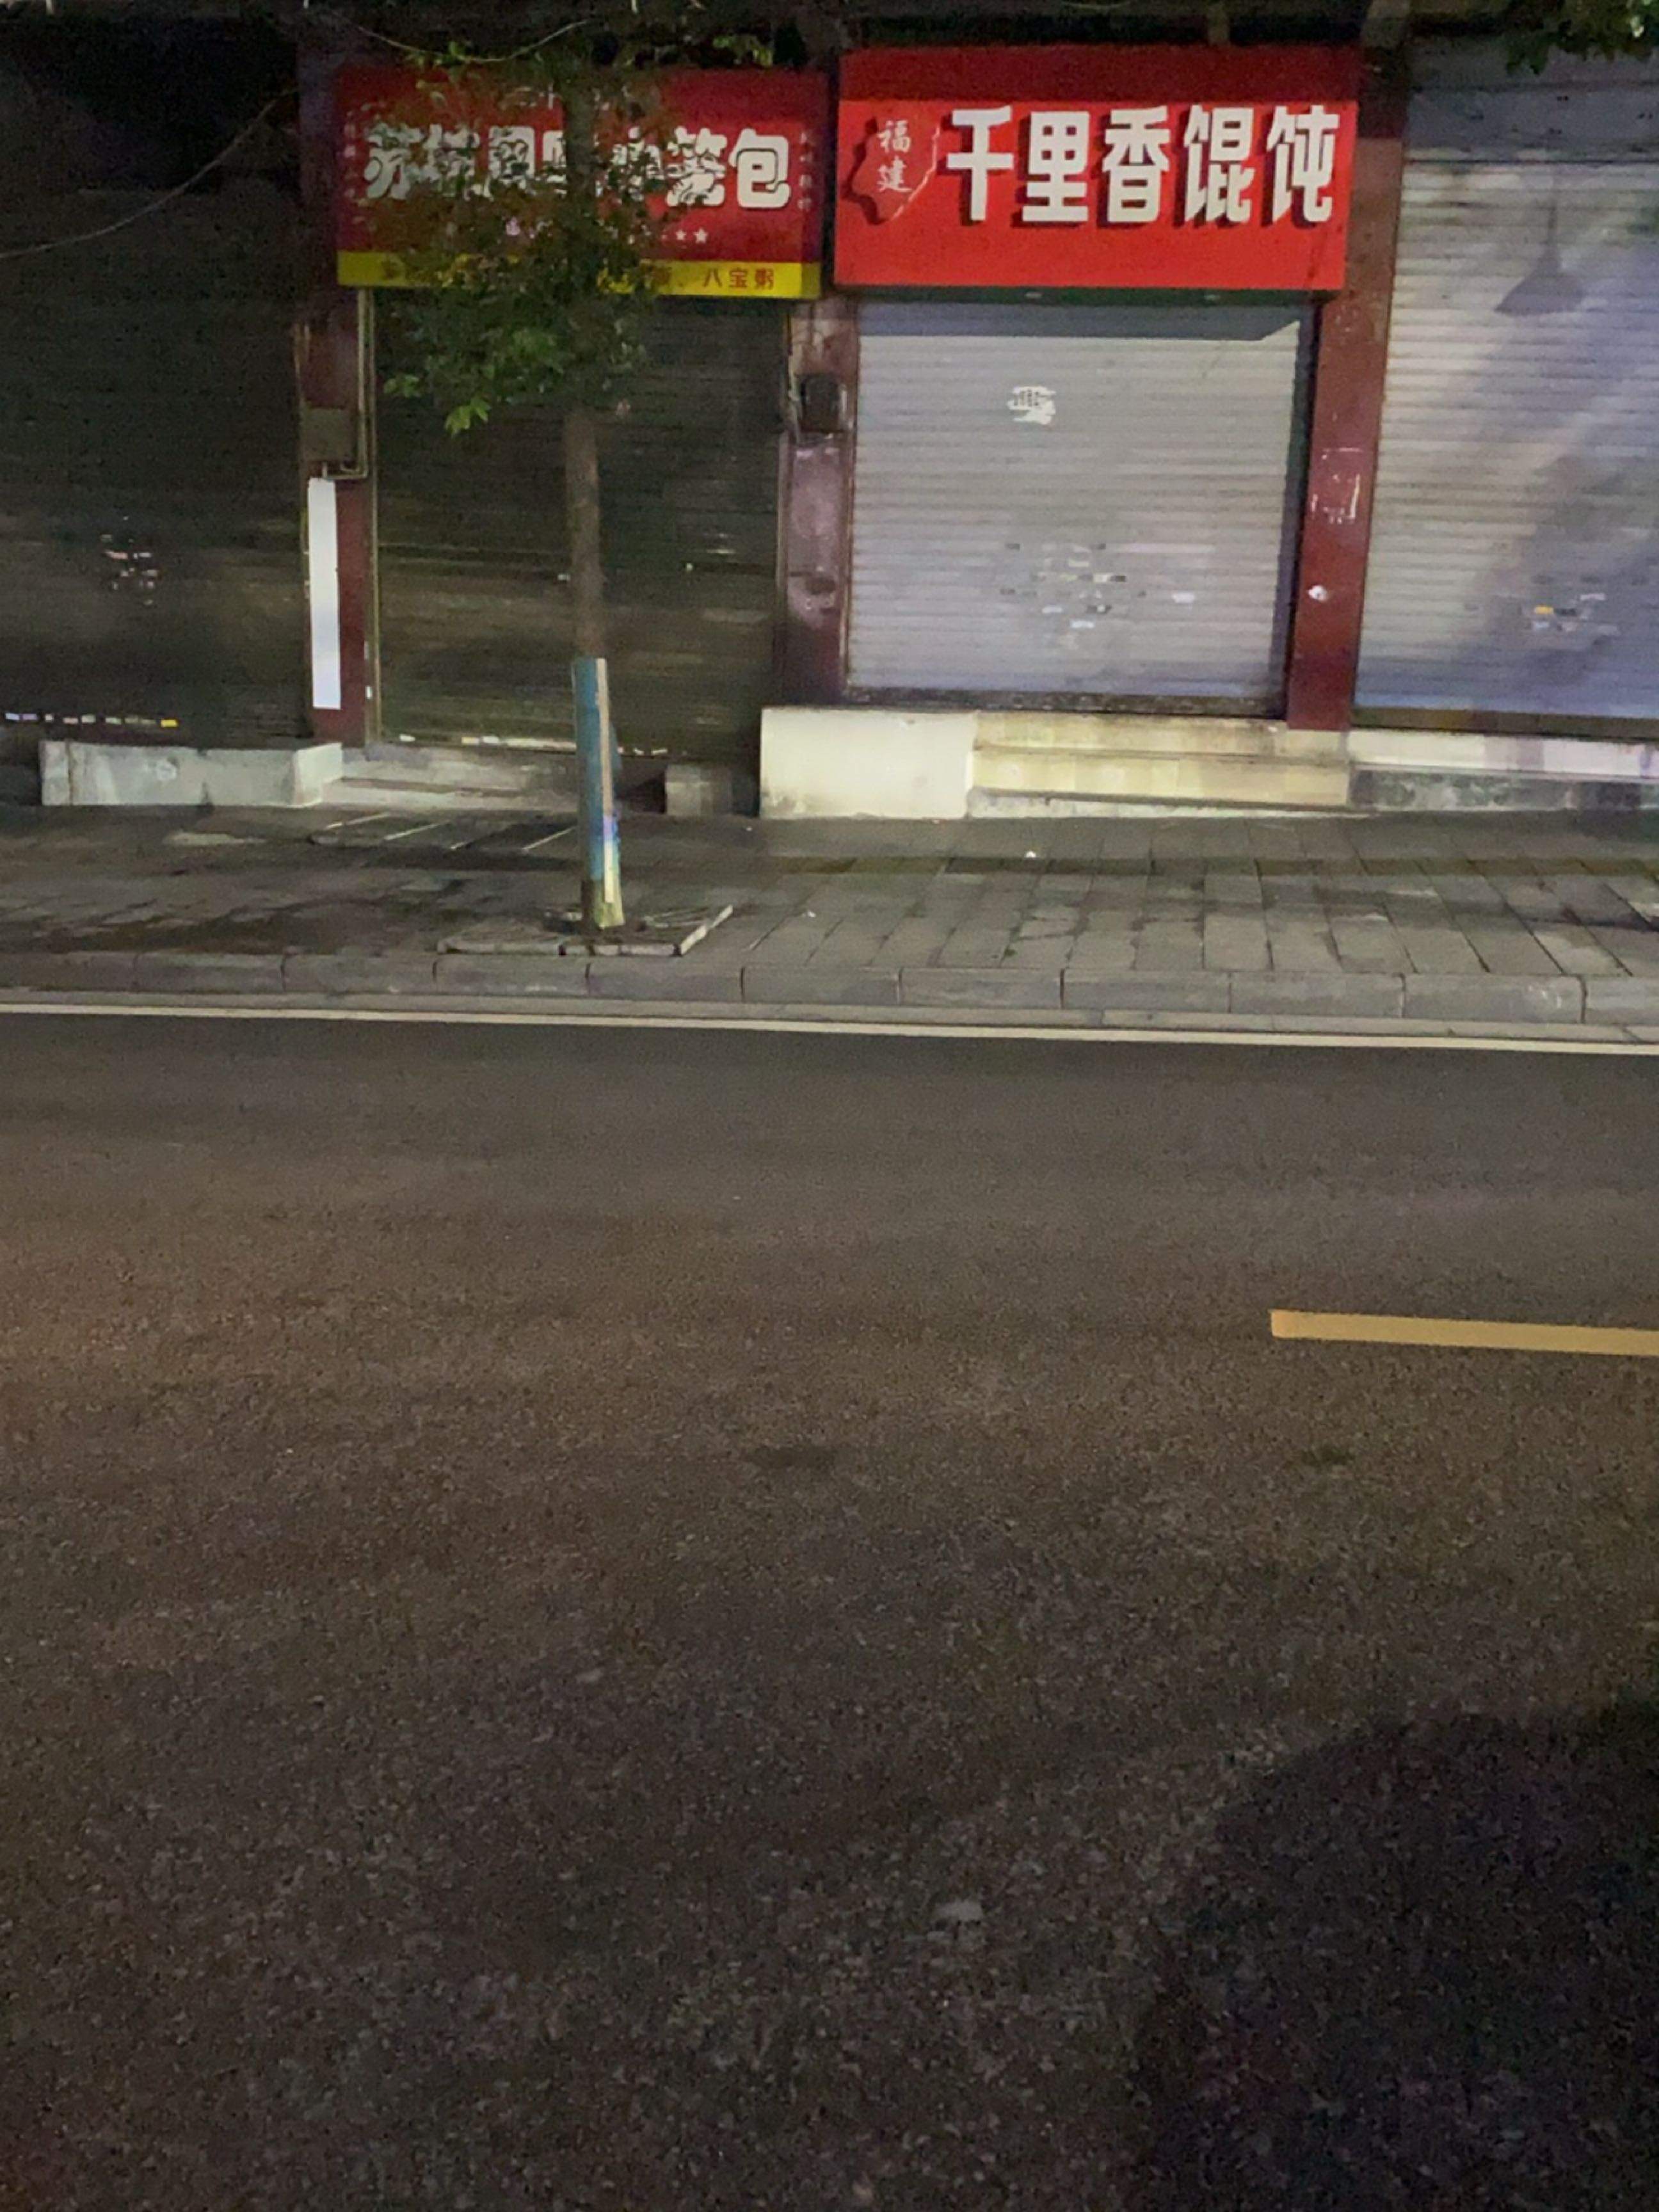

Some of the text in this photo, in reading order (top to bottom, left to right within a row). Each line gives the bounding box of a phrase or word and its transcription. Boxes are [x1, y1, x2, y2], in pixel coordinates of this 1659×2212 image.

[876, 119, 911, 192] 福建
[947, 105, 1339, 223] 千里香馄饨
